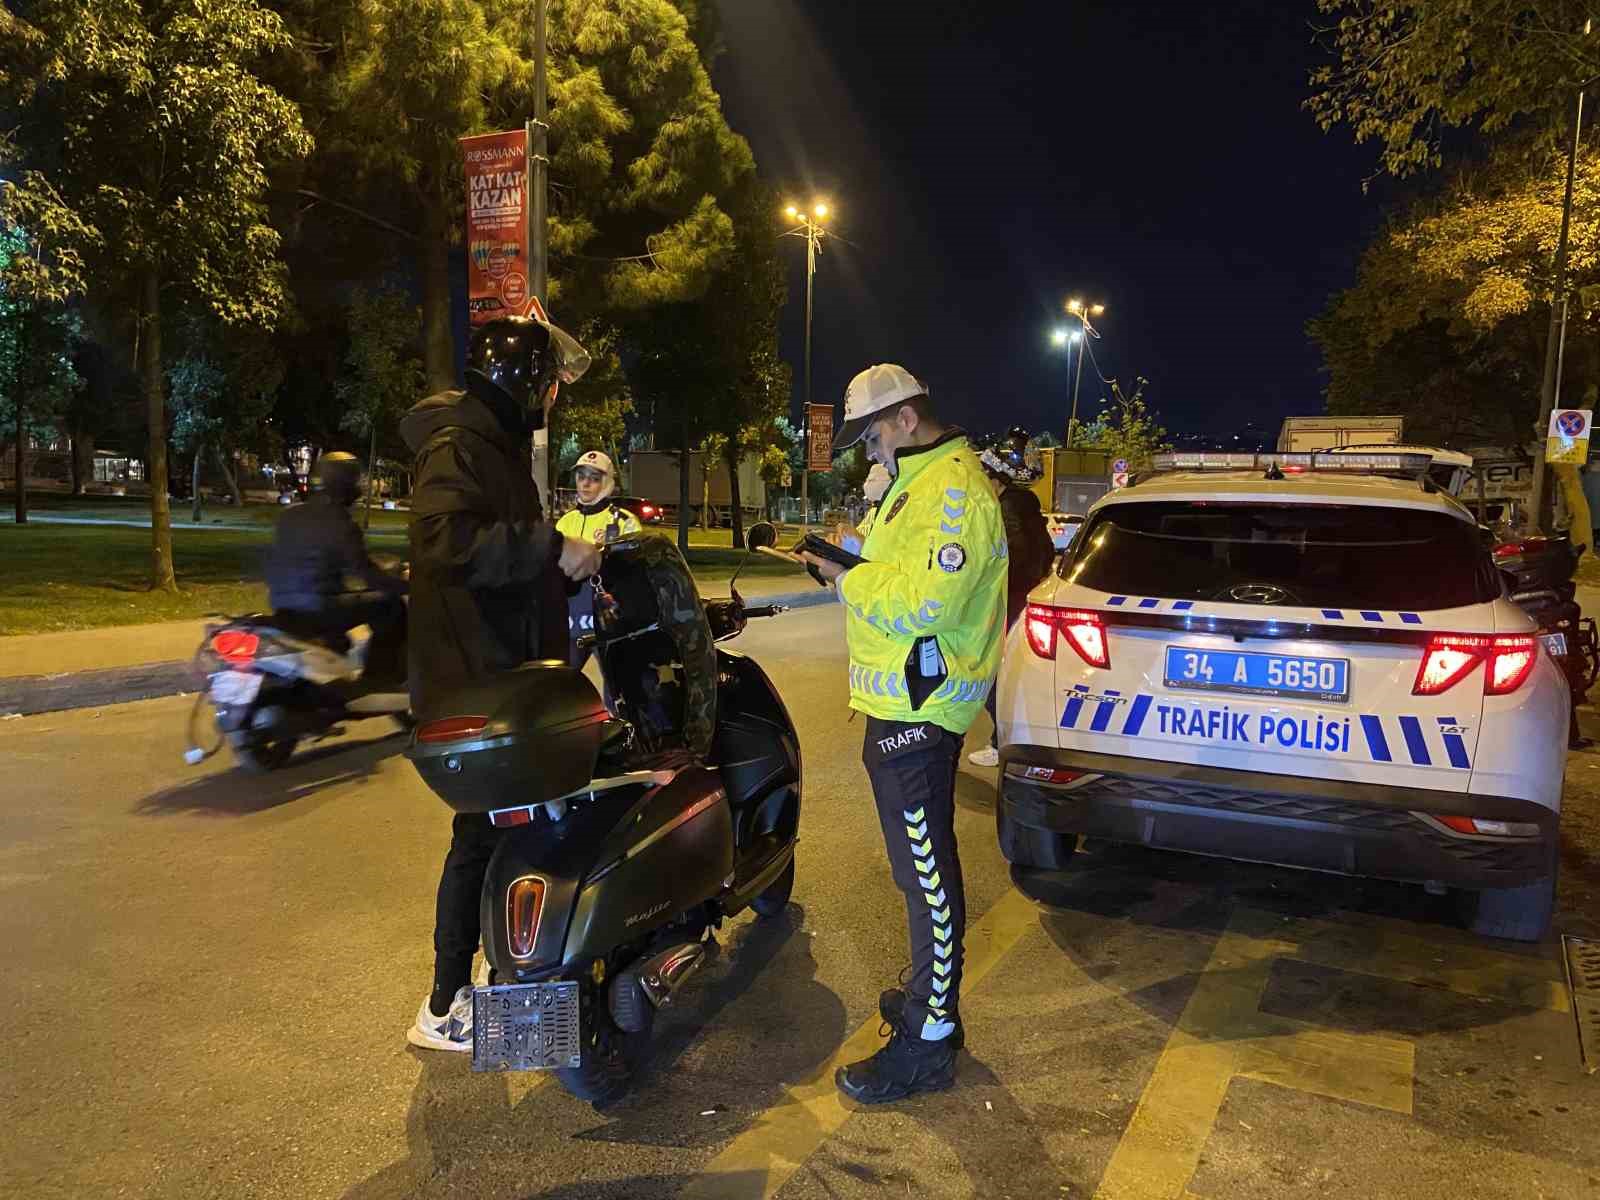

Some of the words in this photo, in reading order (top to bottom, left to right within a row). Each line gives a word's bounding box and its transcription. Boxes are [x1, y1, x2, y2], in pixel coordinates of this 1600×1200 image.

[467, 145, 525, 162] ROSSMANN
[470, 174, 494, 190] KAT
[496, 171, 521, 188] KAT
[470, 187, 521, 209] KAZAN
[1183, 653, 1214, 680] 34
[1233, 656, 1249, 683] A
[1268, 658, 1336, 690] 5650
[877, 726, 928, 753] TRAFIK
[1157, 705, 1250, 742] TRAFİK
[1259, 714, 1350, 753] POLİSİ
